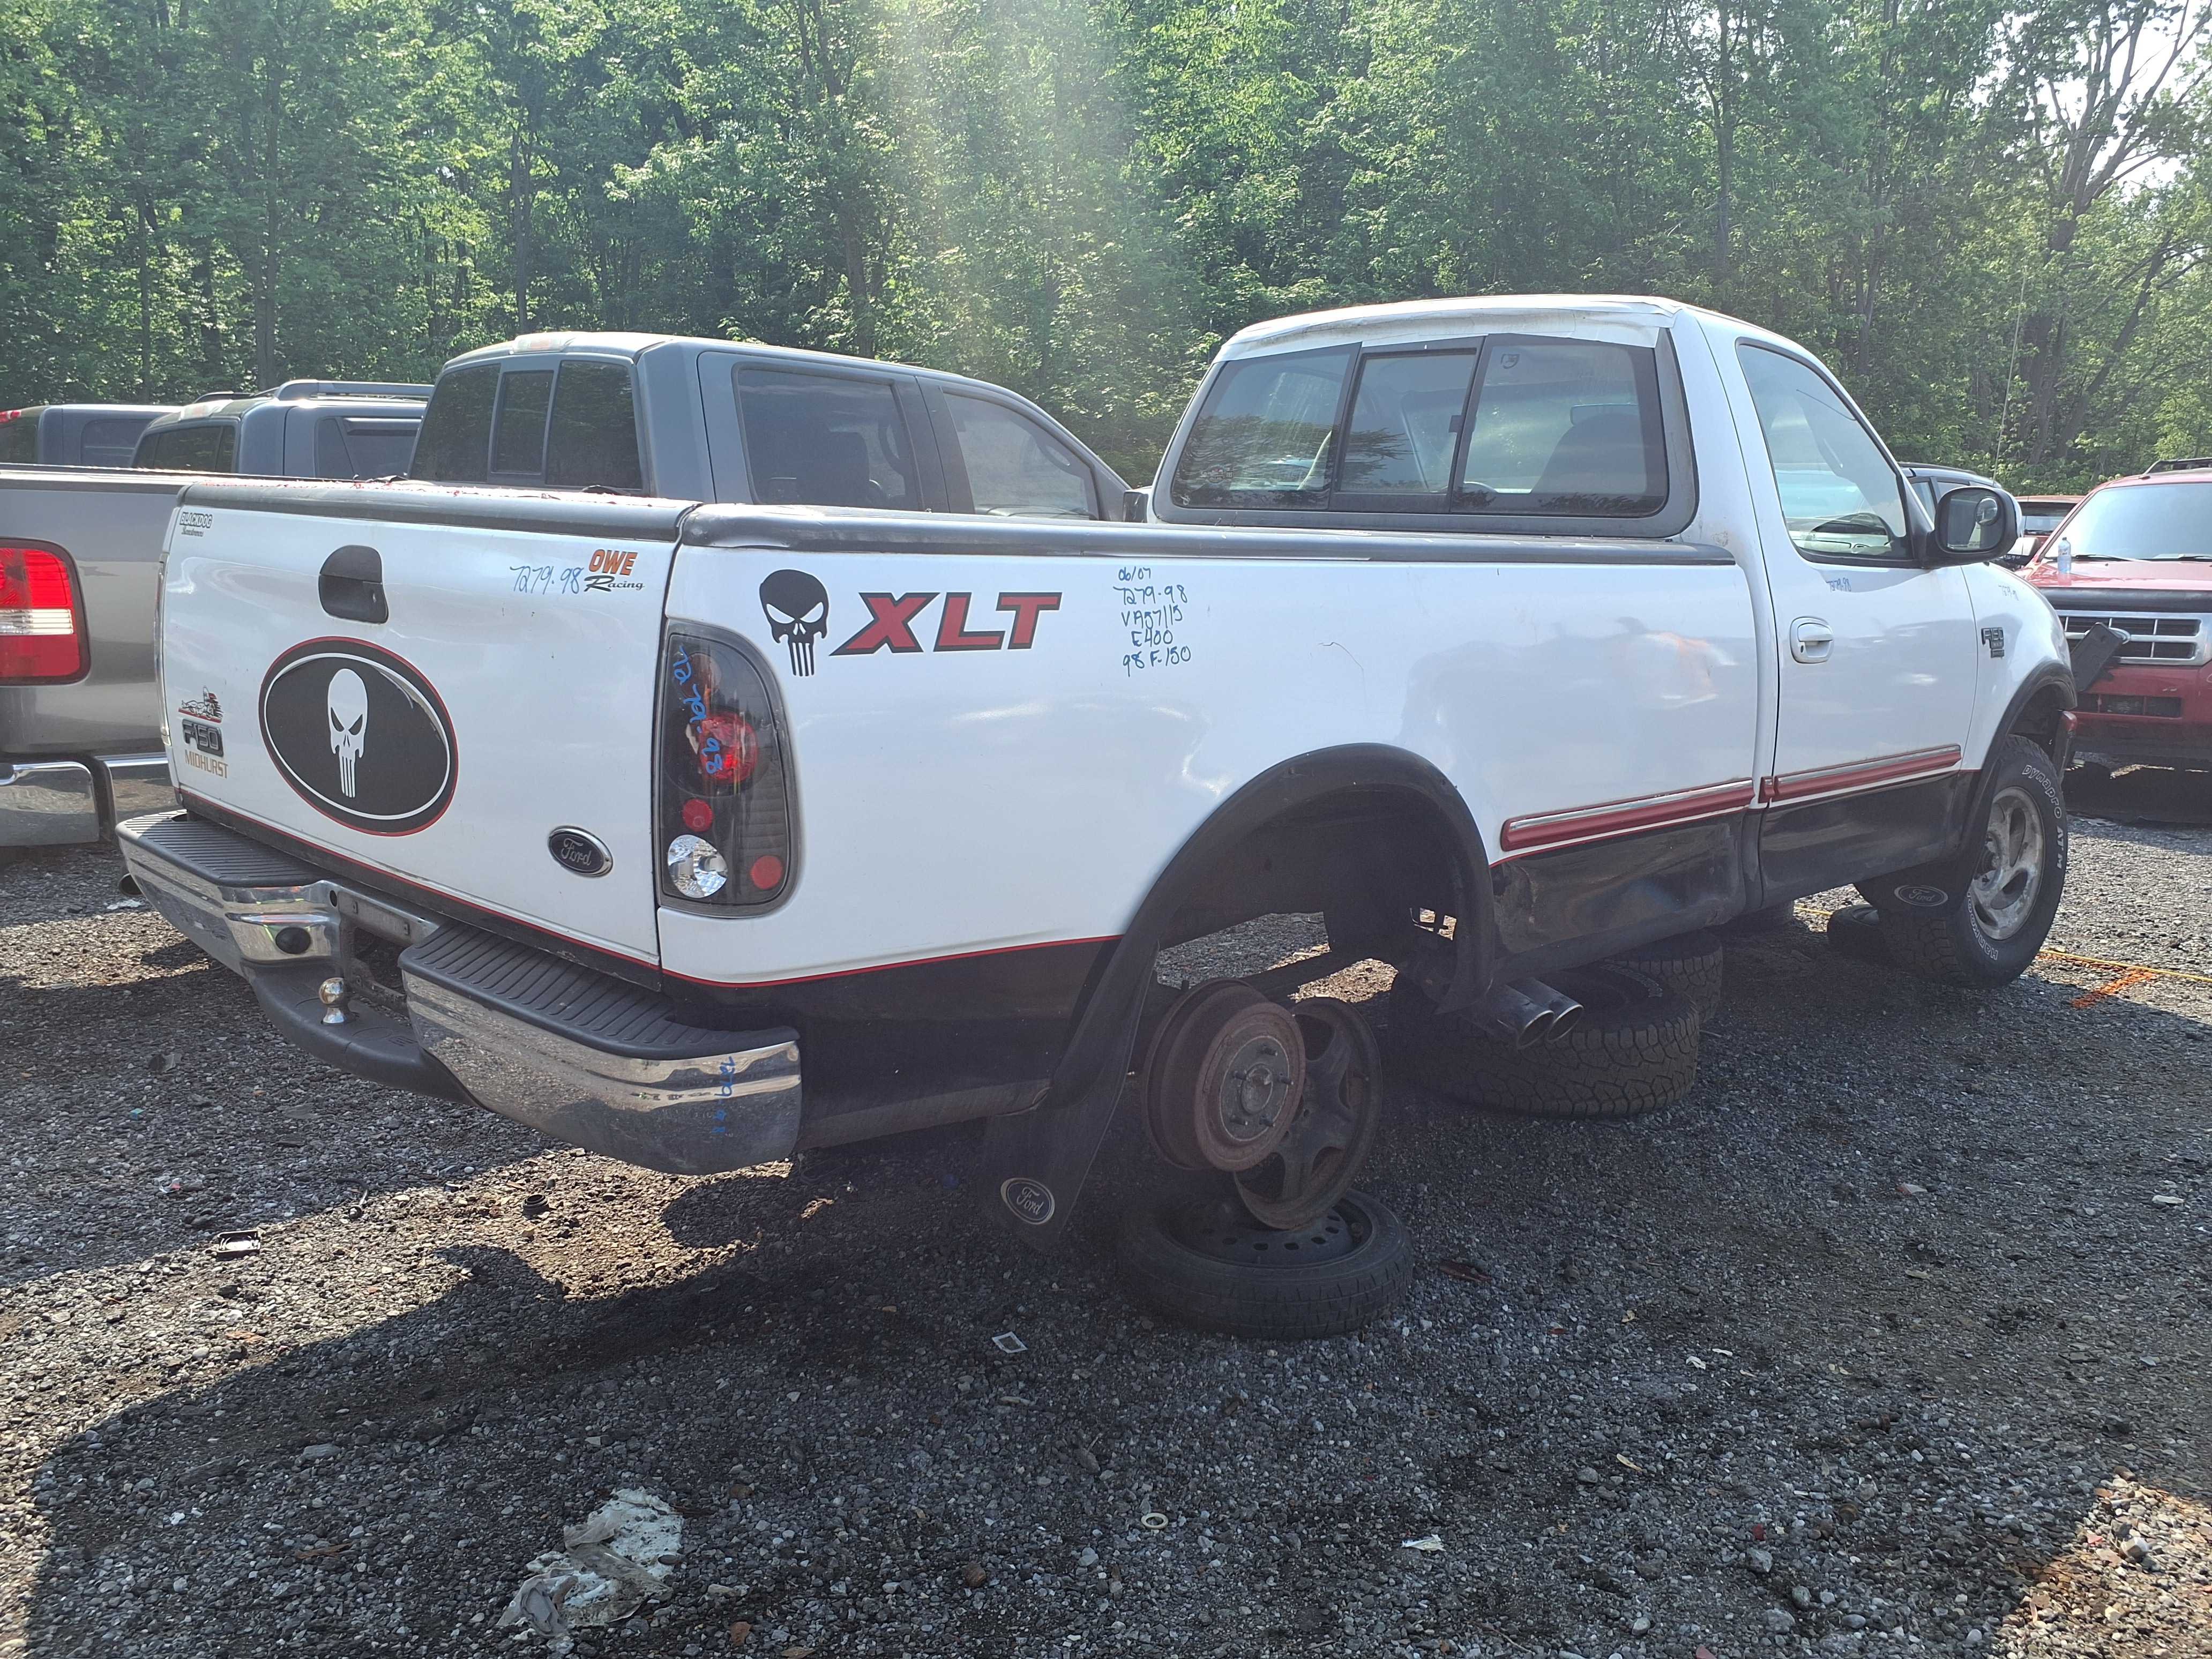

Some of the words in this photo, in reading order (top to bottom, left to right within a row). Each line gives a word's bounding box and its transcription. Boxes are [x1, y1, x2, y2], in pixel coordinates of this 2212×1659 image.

[180, 512, 213, 528] BLACKDOG
[588, 549, 638, 576] OWE
[1118, 566, 1151, 581] 06/07
[584, 575, 645, 592] Racing
[828, 592, 1063, 656] XLT
[185, 749, 228, 778] MIDHURST
[2022, 765, 2062, 819] Dynapro
[561, 838, 592, 866] Ford
[1909, 888, 1935, 901] Ford
[1016, 1186, 1044, 1215] Ford
